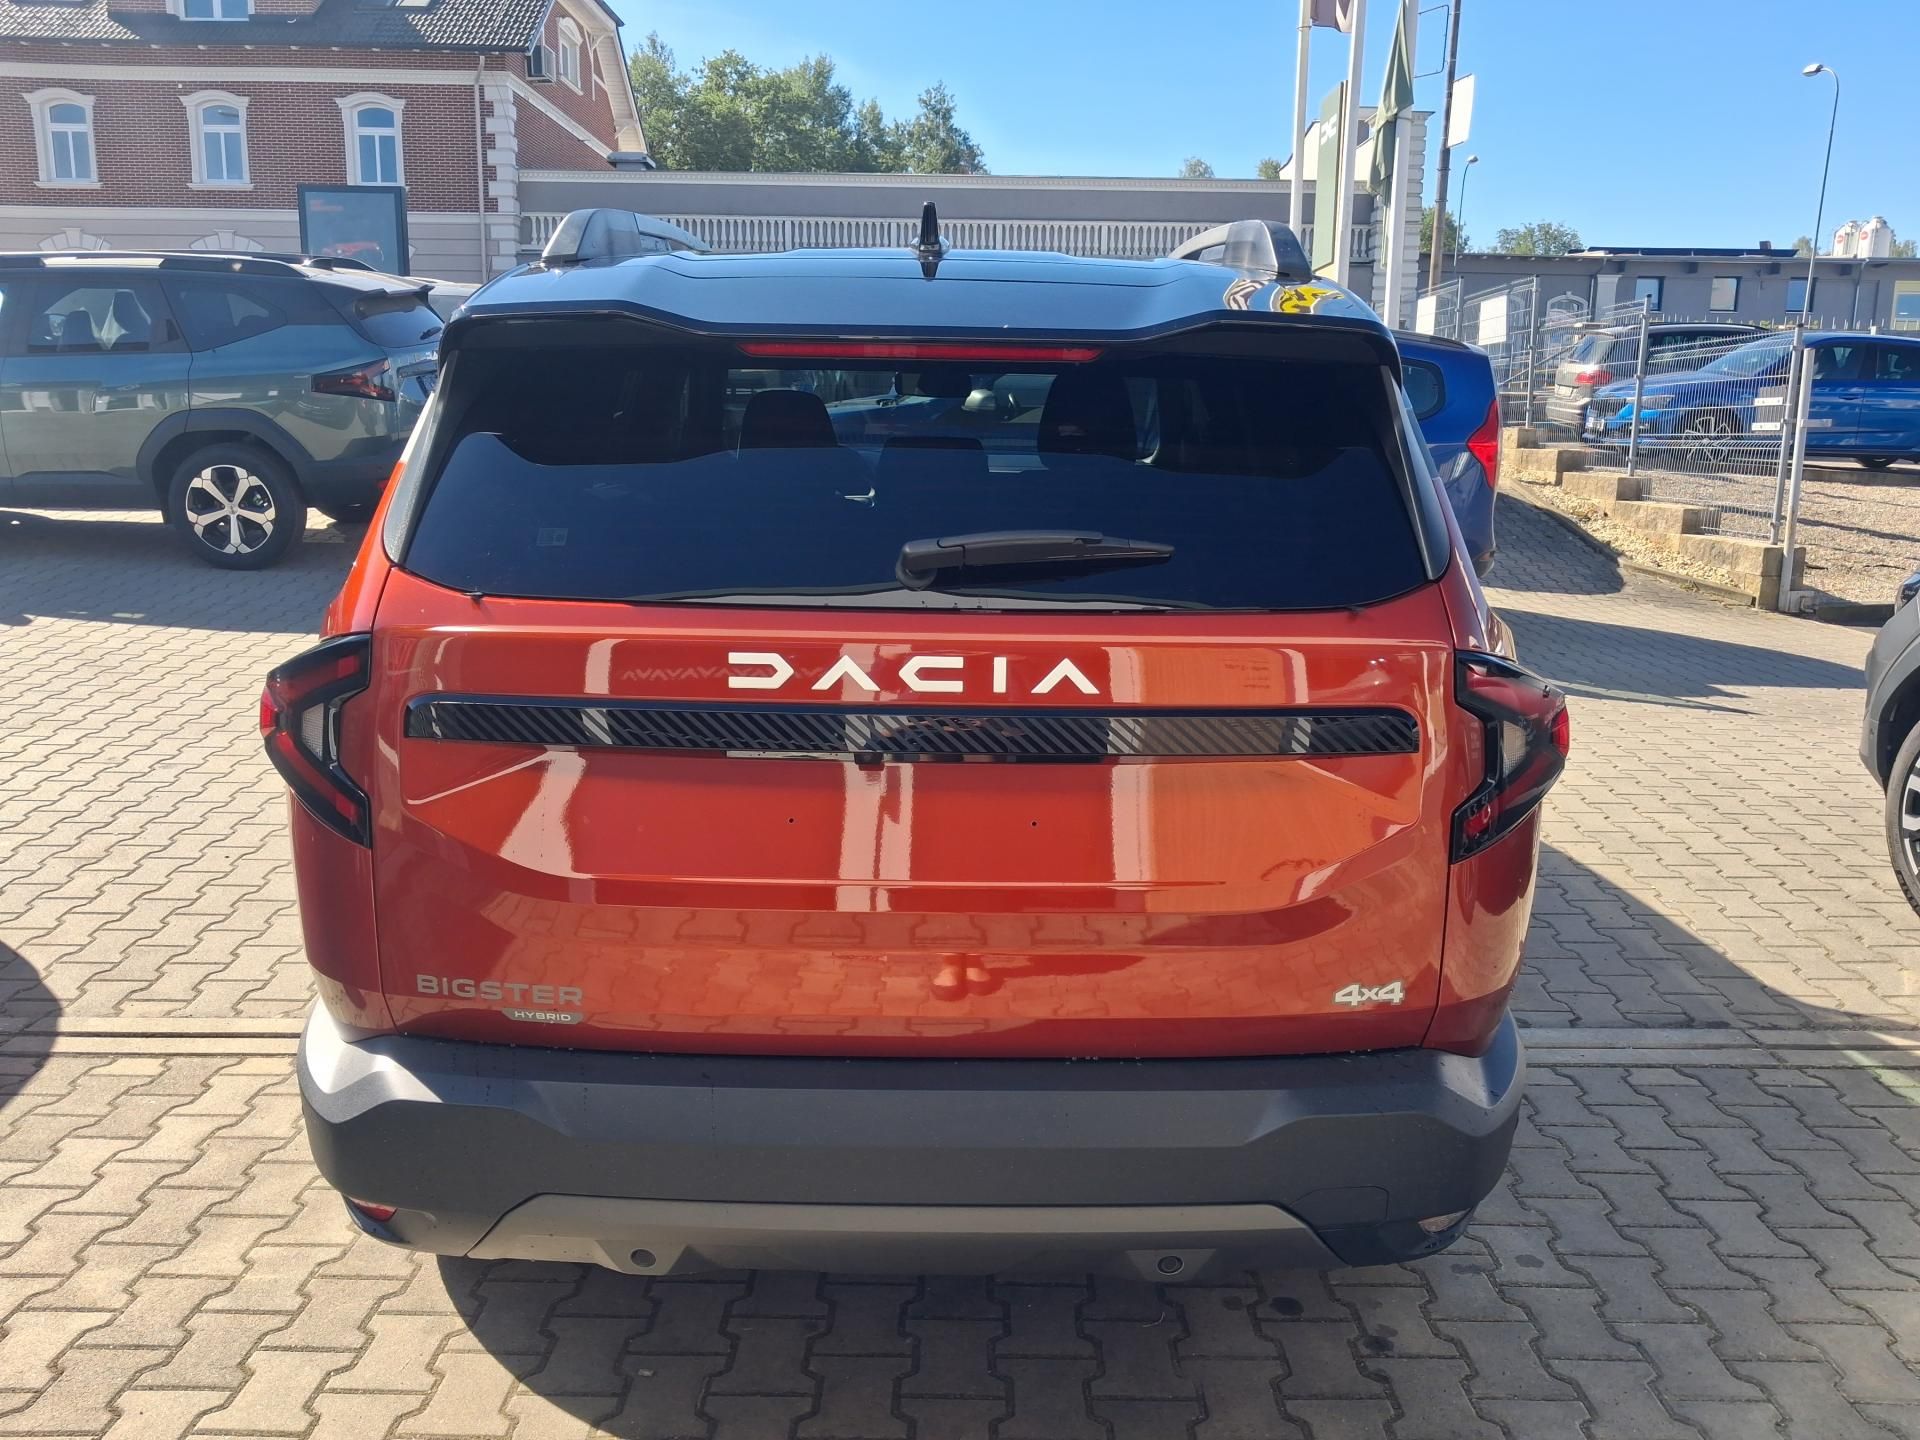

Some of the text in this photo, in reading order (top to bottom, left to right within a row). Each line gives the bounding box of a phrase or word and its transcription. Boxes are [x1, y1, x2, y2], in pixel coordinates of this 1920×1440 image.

[728, 652, 1100, 695] DACIA
[416, 974, 584, 1006] BIGSTER
[1334, 981, 1404, 1006] 4x4
[514, 1010, 572, 1022] HYBRID
